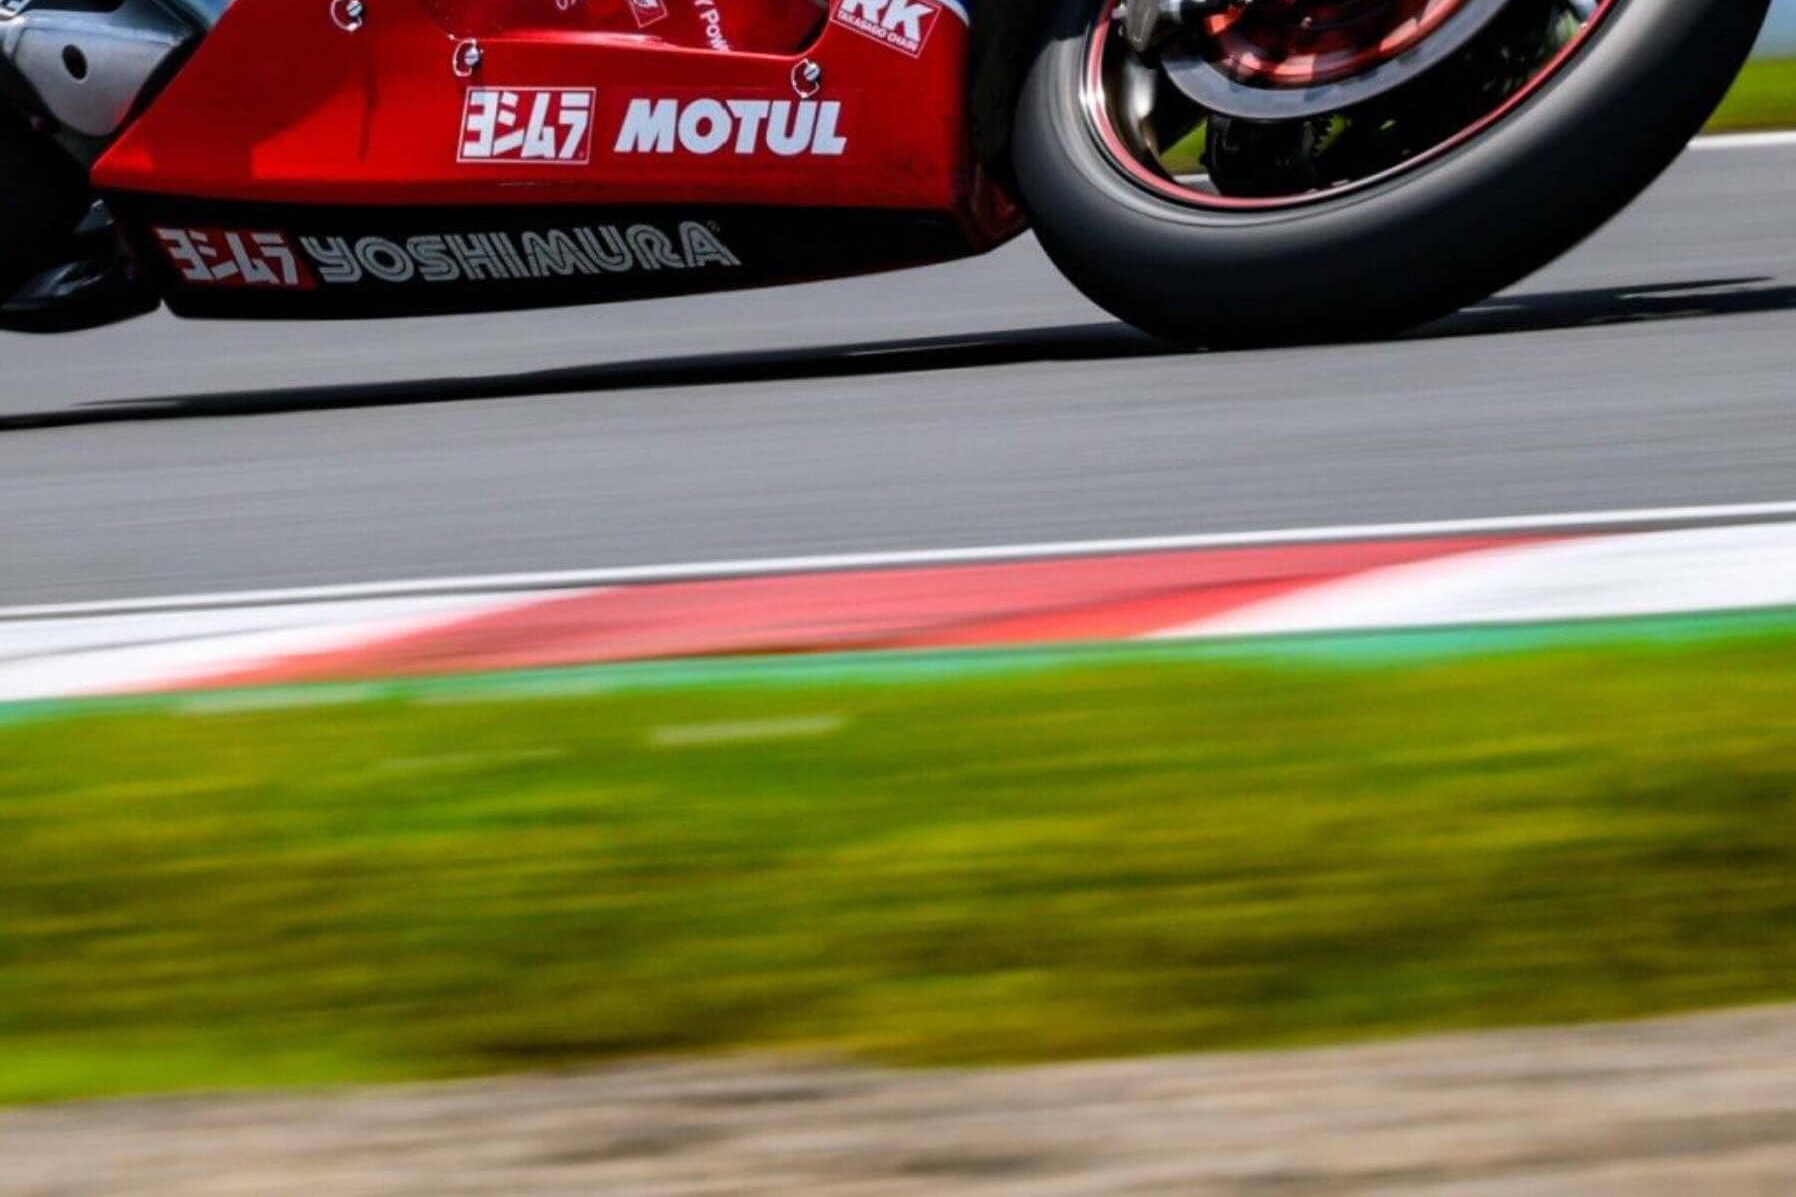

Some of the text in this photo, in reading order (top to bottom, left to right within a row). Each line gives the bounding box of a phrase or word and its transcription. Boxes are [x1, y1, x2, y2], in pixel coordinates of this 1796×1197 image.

[463, 91, 589, 159] ヨシムラ
[614, 99, 848, 155] MOTUL
[156, 228, 299, 285] ヨシムラ
[300, 221, 742, 283] YOSHIMURA
